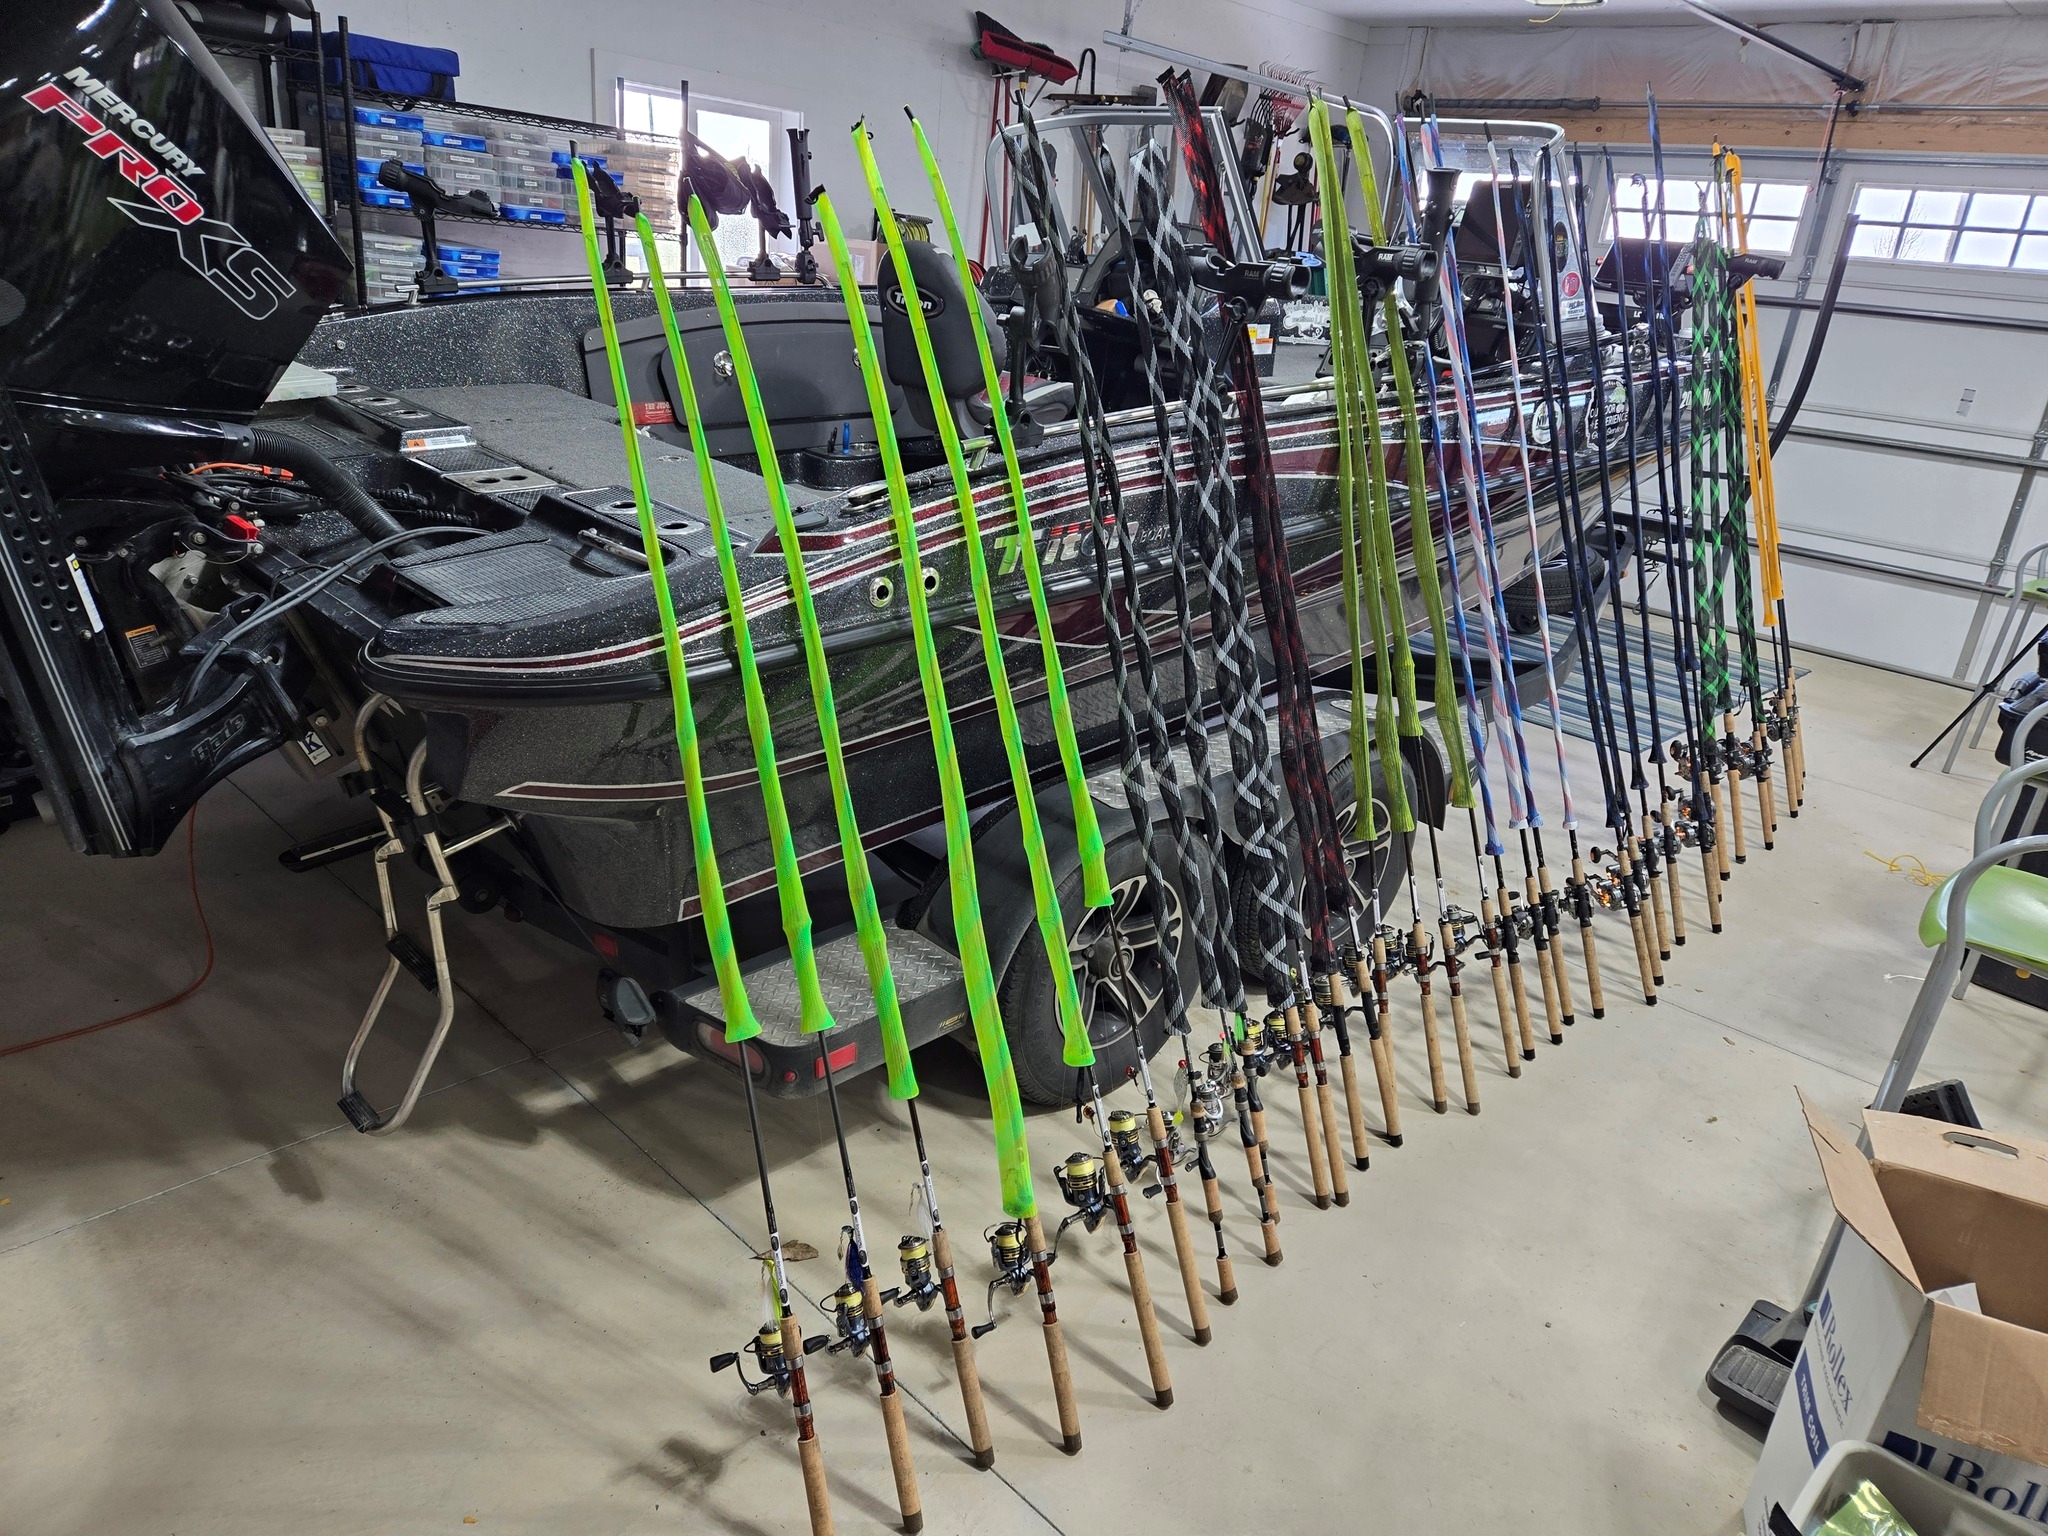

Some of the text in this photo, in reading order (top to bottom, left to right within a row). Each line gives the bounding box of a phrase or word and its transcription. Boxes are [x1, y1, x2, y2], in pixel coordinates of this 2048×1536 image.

[63, 66, 205, 177] MERCURY
[21, 82, 204, 226] PRO
[106, 168, 297, 320] XS
[1378, 253, 1394, 262] RAM
[894, 291, 933, 310] Tron
[1244, 269, 1260, 278] RAM
[1593, 413, 1628, 430] EERIENCE
[993, 520, 1171, 576] Titon BOAT
[1801, 1373, 1821, 1456] TRIM COIL
